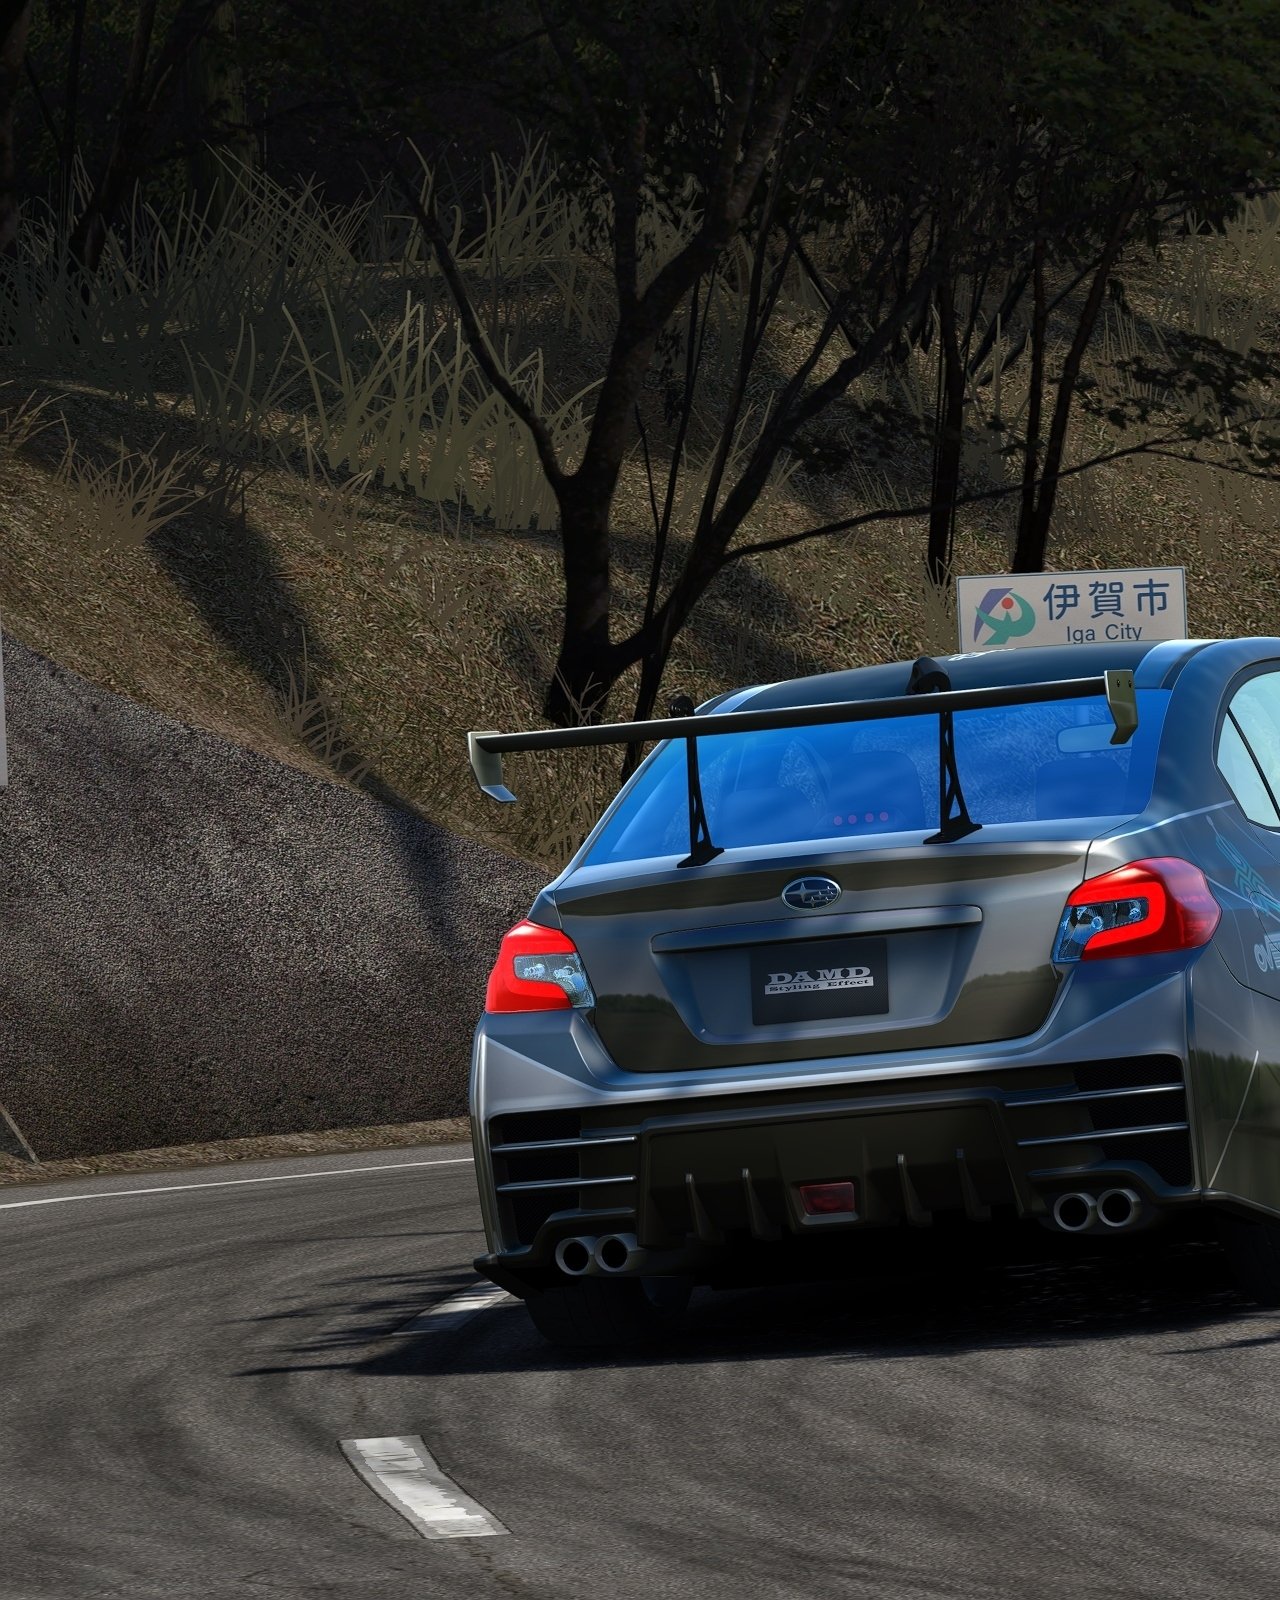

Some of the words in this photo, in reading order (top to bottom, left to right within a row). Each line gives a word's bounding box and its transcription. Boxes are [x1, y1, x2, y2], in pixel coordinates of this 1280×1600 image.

[1043, 579, 1169, 620] 伊賀市
[1067, 626, 1095, 644] Iga
[1105, 623, 1142, 641] City
[768, 966, 871, 985] DAMD
[769, 984, 820, 992] Styling
